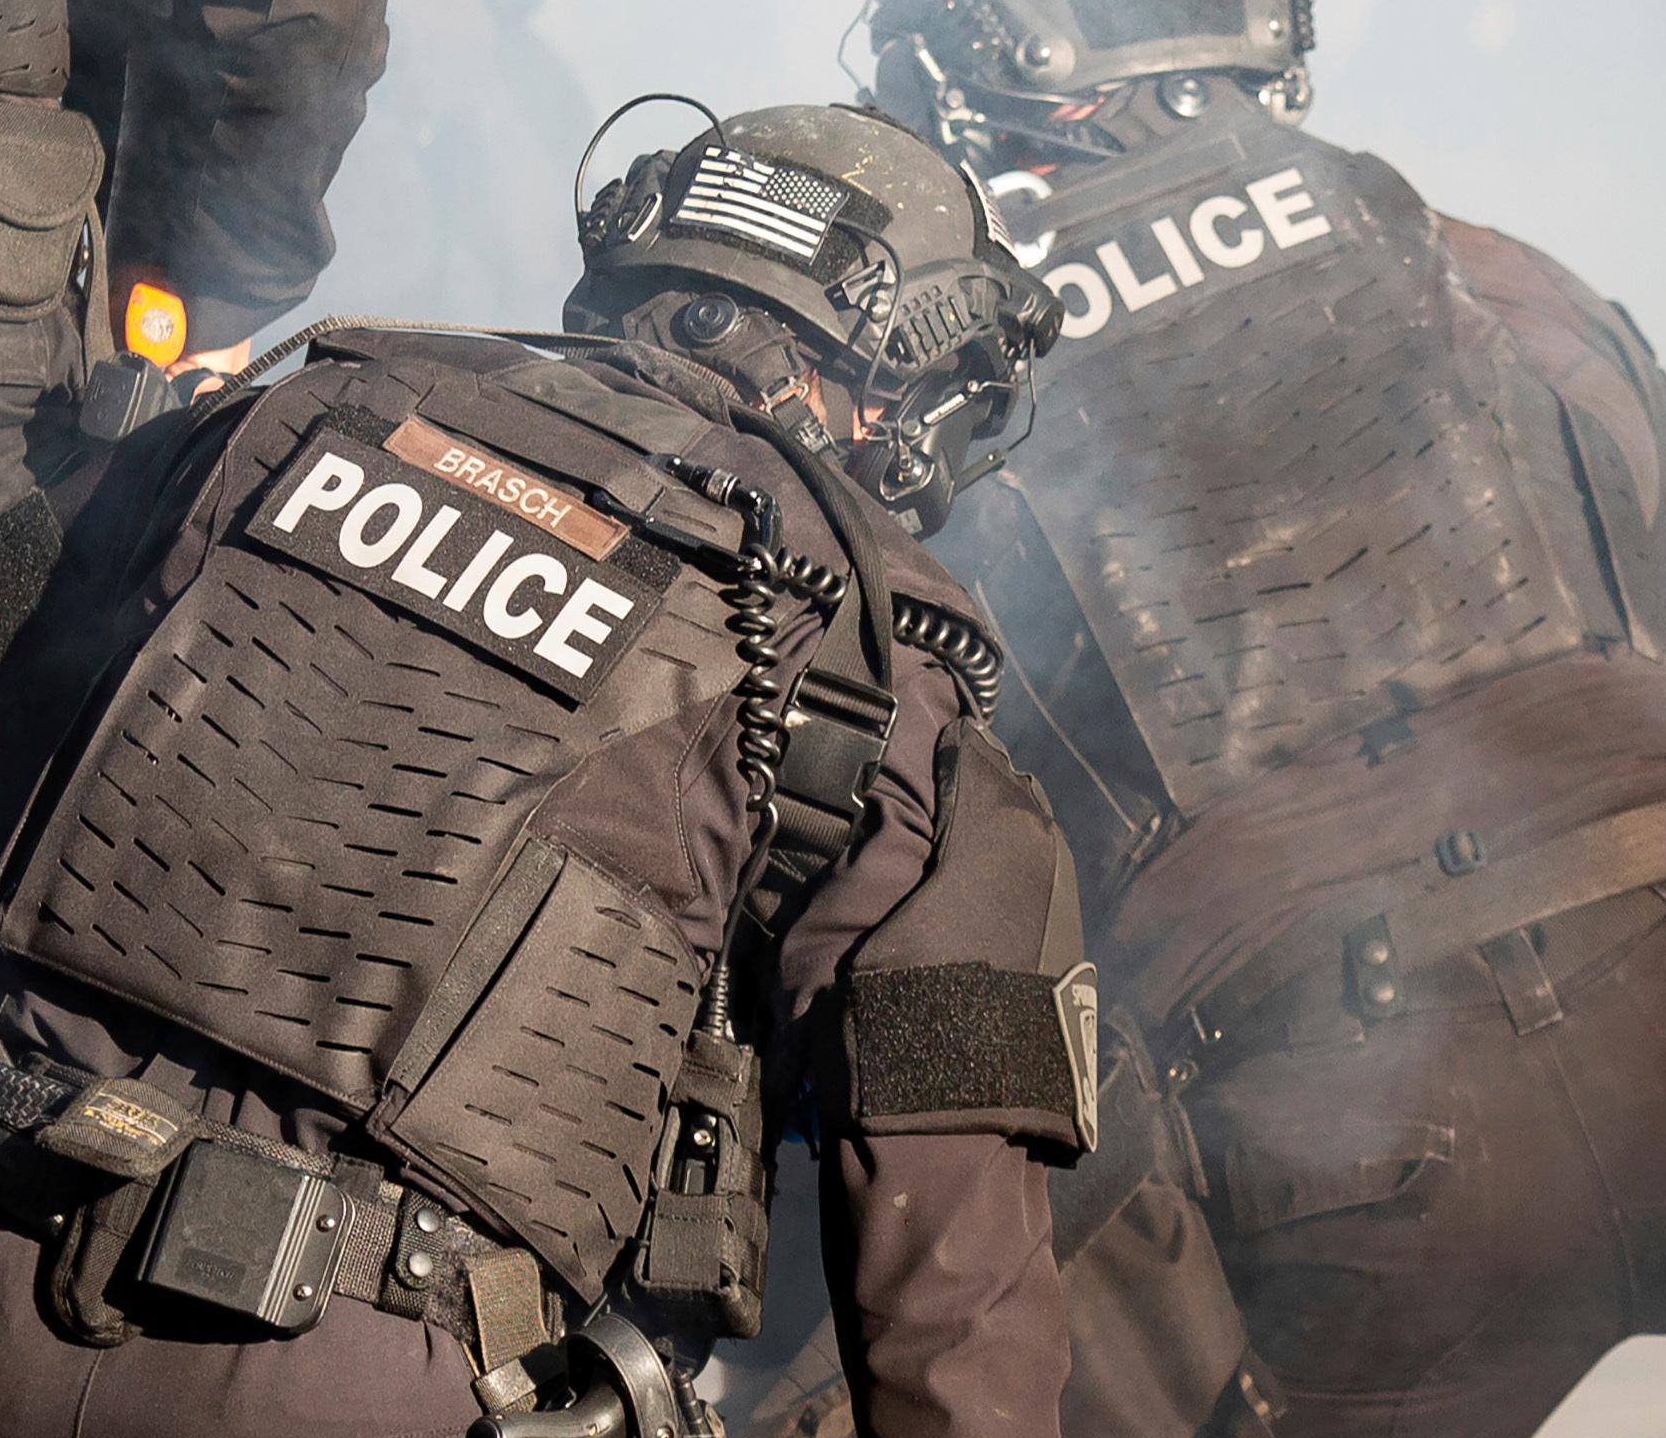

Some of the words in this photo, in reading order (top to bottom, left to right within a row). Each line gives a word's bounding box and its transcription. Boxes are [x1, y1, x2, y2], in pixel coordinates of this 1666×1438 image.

[1041, 166, 1332, 340] OLICE
[272, 451, 635, 680] POLICE
[432, 446, 572, 529] BRASCH
